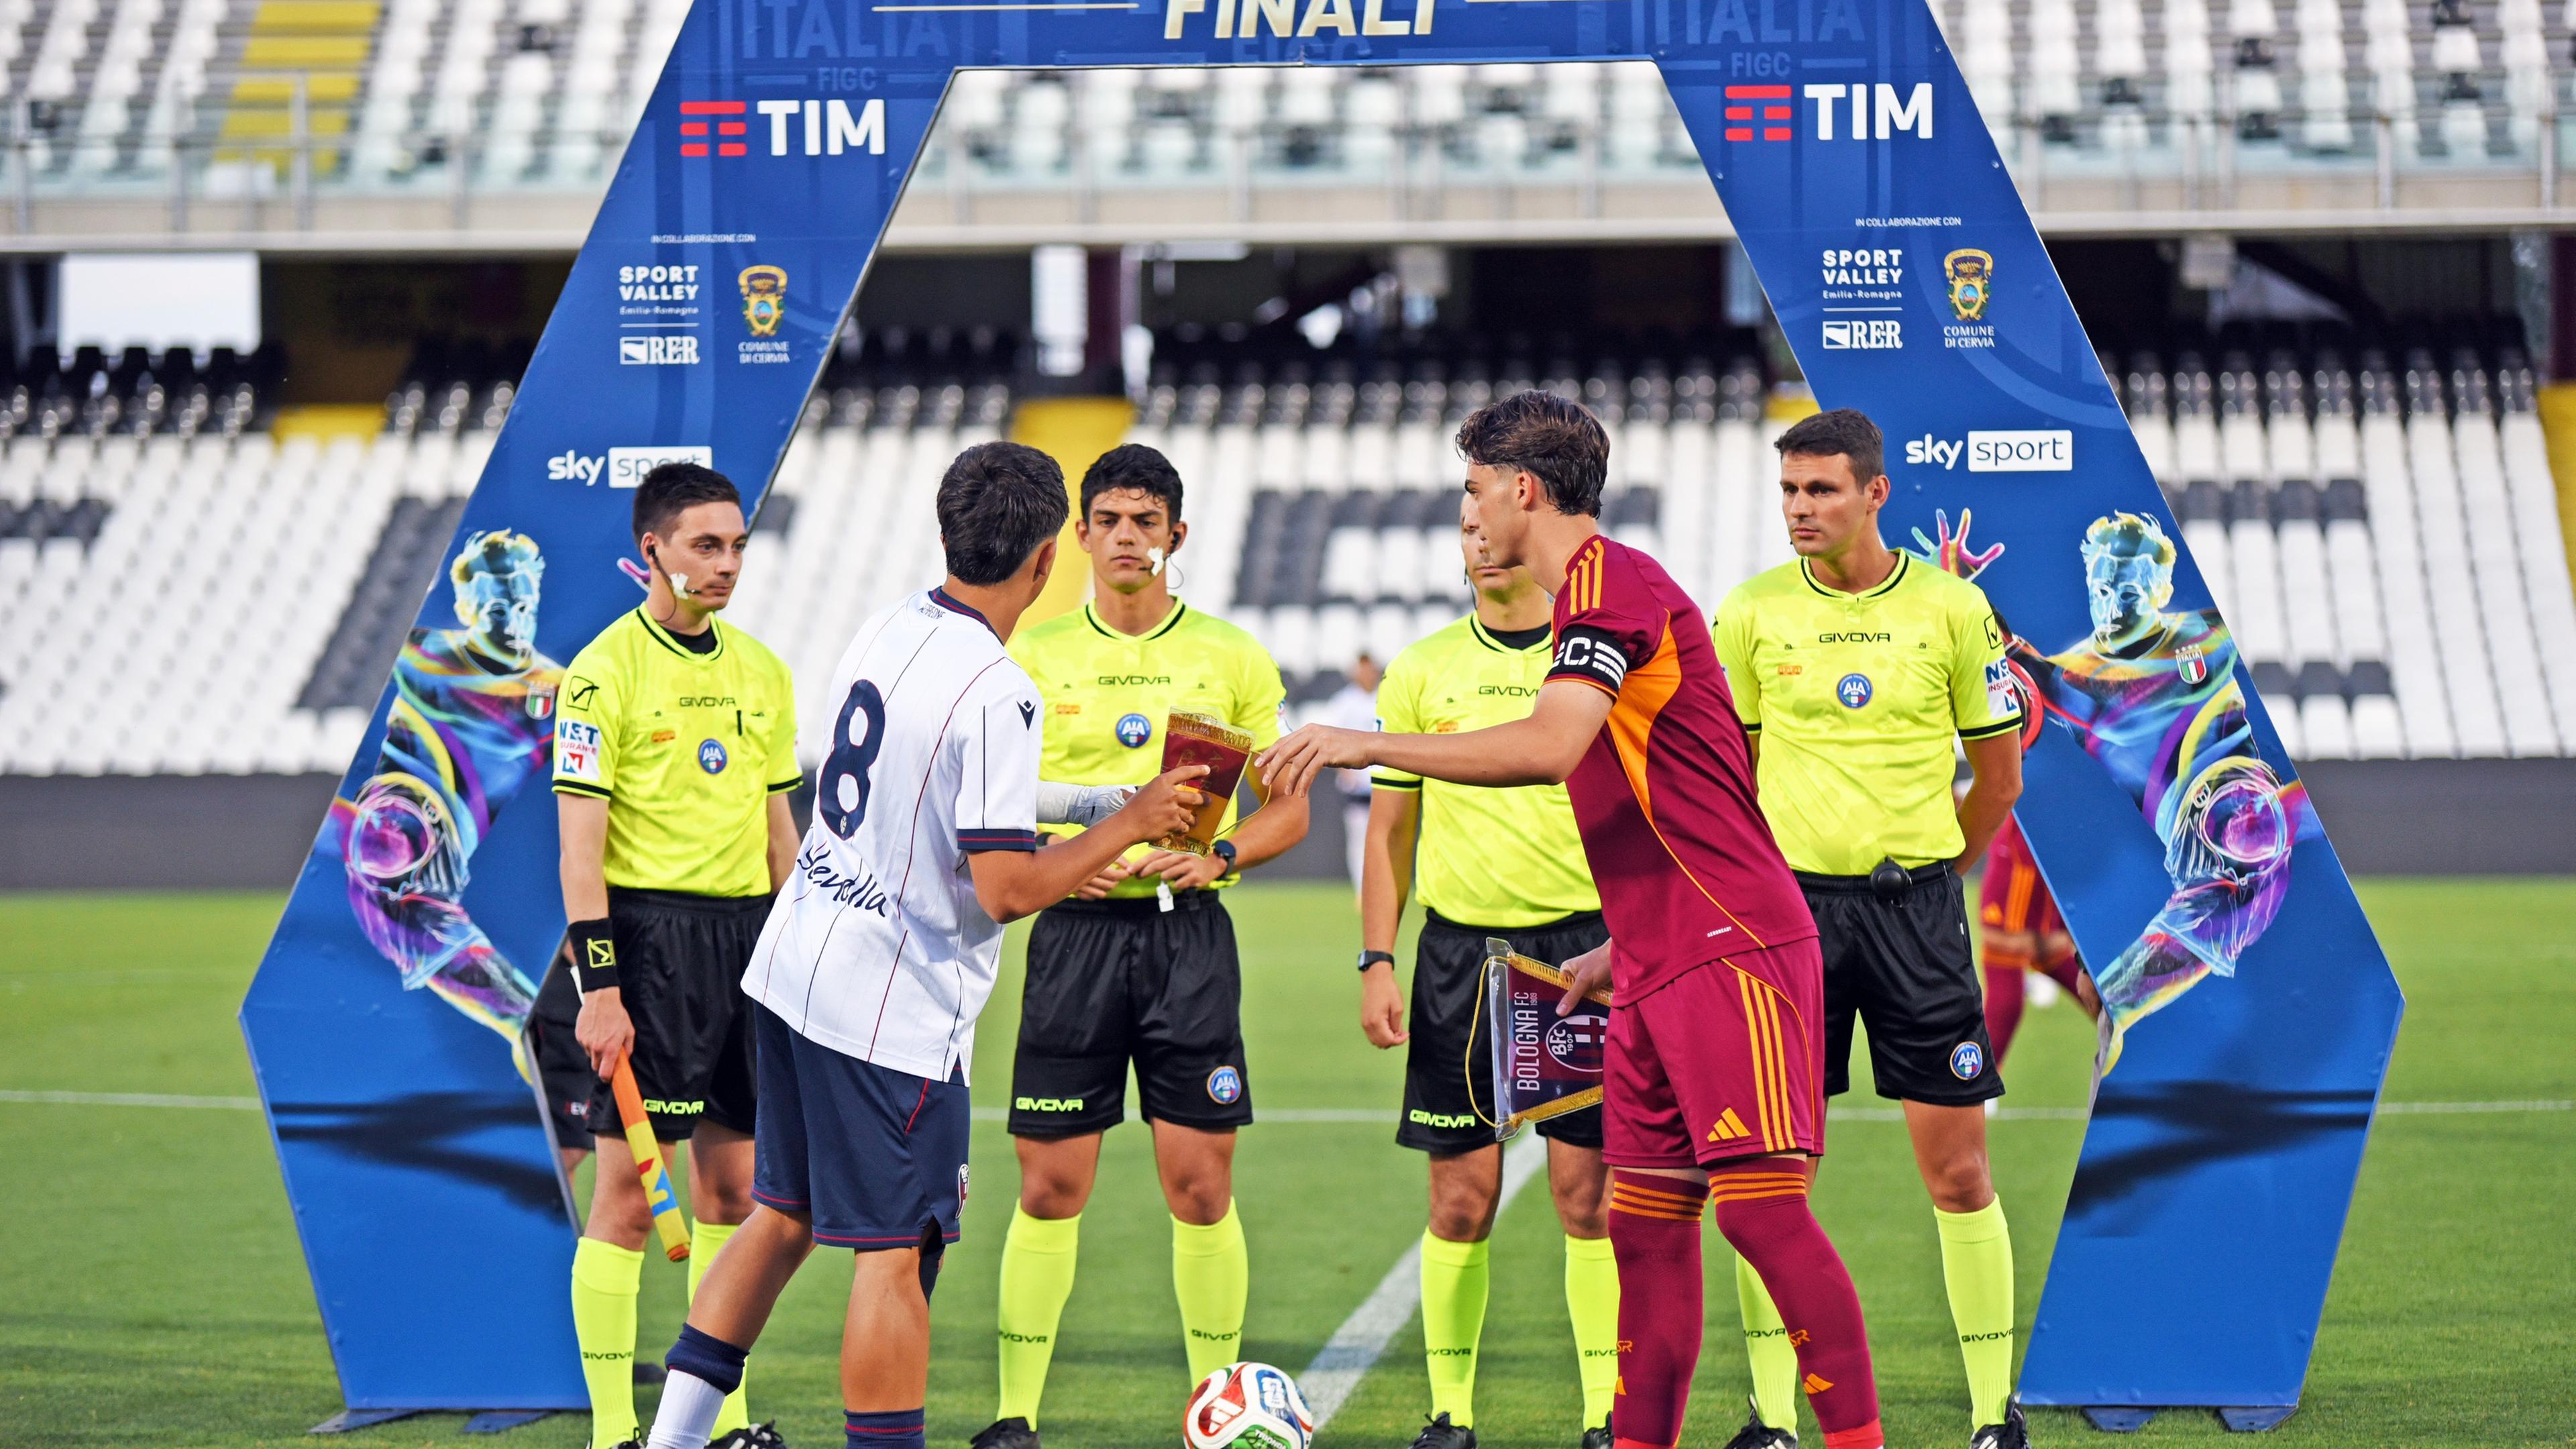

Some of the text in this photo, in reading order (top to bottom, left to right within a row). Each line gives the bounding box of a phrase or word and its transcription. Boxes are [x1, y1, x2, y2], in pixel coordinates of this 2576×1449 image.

[1164, 0, 1436, 39] FINALI
[1731, 52, 1792, 78] FIGC
[816, 66, 877, 91] FIGC
[1803, 83, 1933, 141] TIM
[757, 99, 885, 156] TIM
[1856, 216, 1962, 227] IN COLLABORAZIONE CON
[1823, 249, 1902, 267] SPORT
[619, 265, 699, 283] SPORT
[1823, 268, 1902, 284] VALLEY
[619, 284, 699, 301] VALLEY
[1823, 290, 1902, 300] Emilia-Romagna
[619, 306, 698, 316] Emilia-Romagna
[1851, 320, 1903, 349] RER
[1943, 325, 1995, 336] COMUNE
[649, 336, 700, 365] RER
[1945, 337, 1995, 348] DI CERVIA
[1905, 433, 2063, 470] sky sport
[547, 449, 605, 486] sky
[1819, 633, 1890, 643] GIVOVA
[1098, 676, 1171, 686] GIVOVA
[819, 679, 885, 841] 8
[1514, 991, 1540, 1091] BOLOGNA FC
[1550, 1028, 1567, 1055] BFC
[643, 1099, 704, 1114] GIVOVA
[1016, 1097, 1083, 1112] GIVOVA
[1409, 1109, 1475, 1128] GIVOVA
